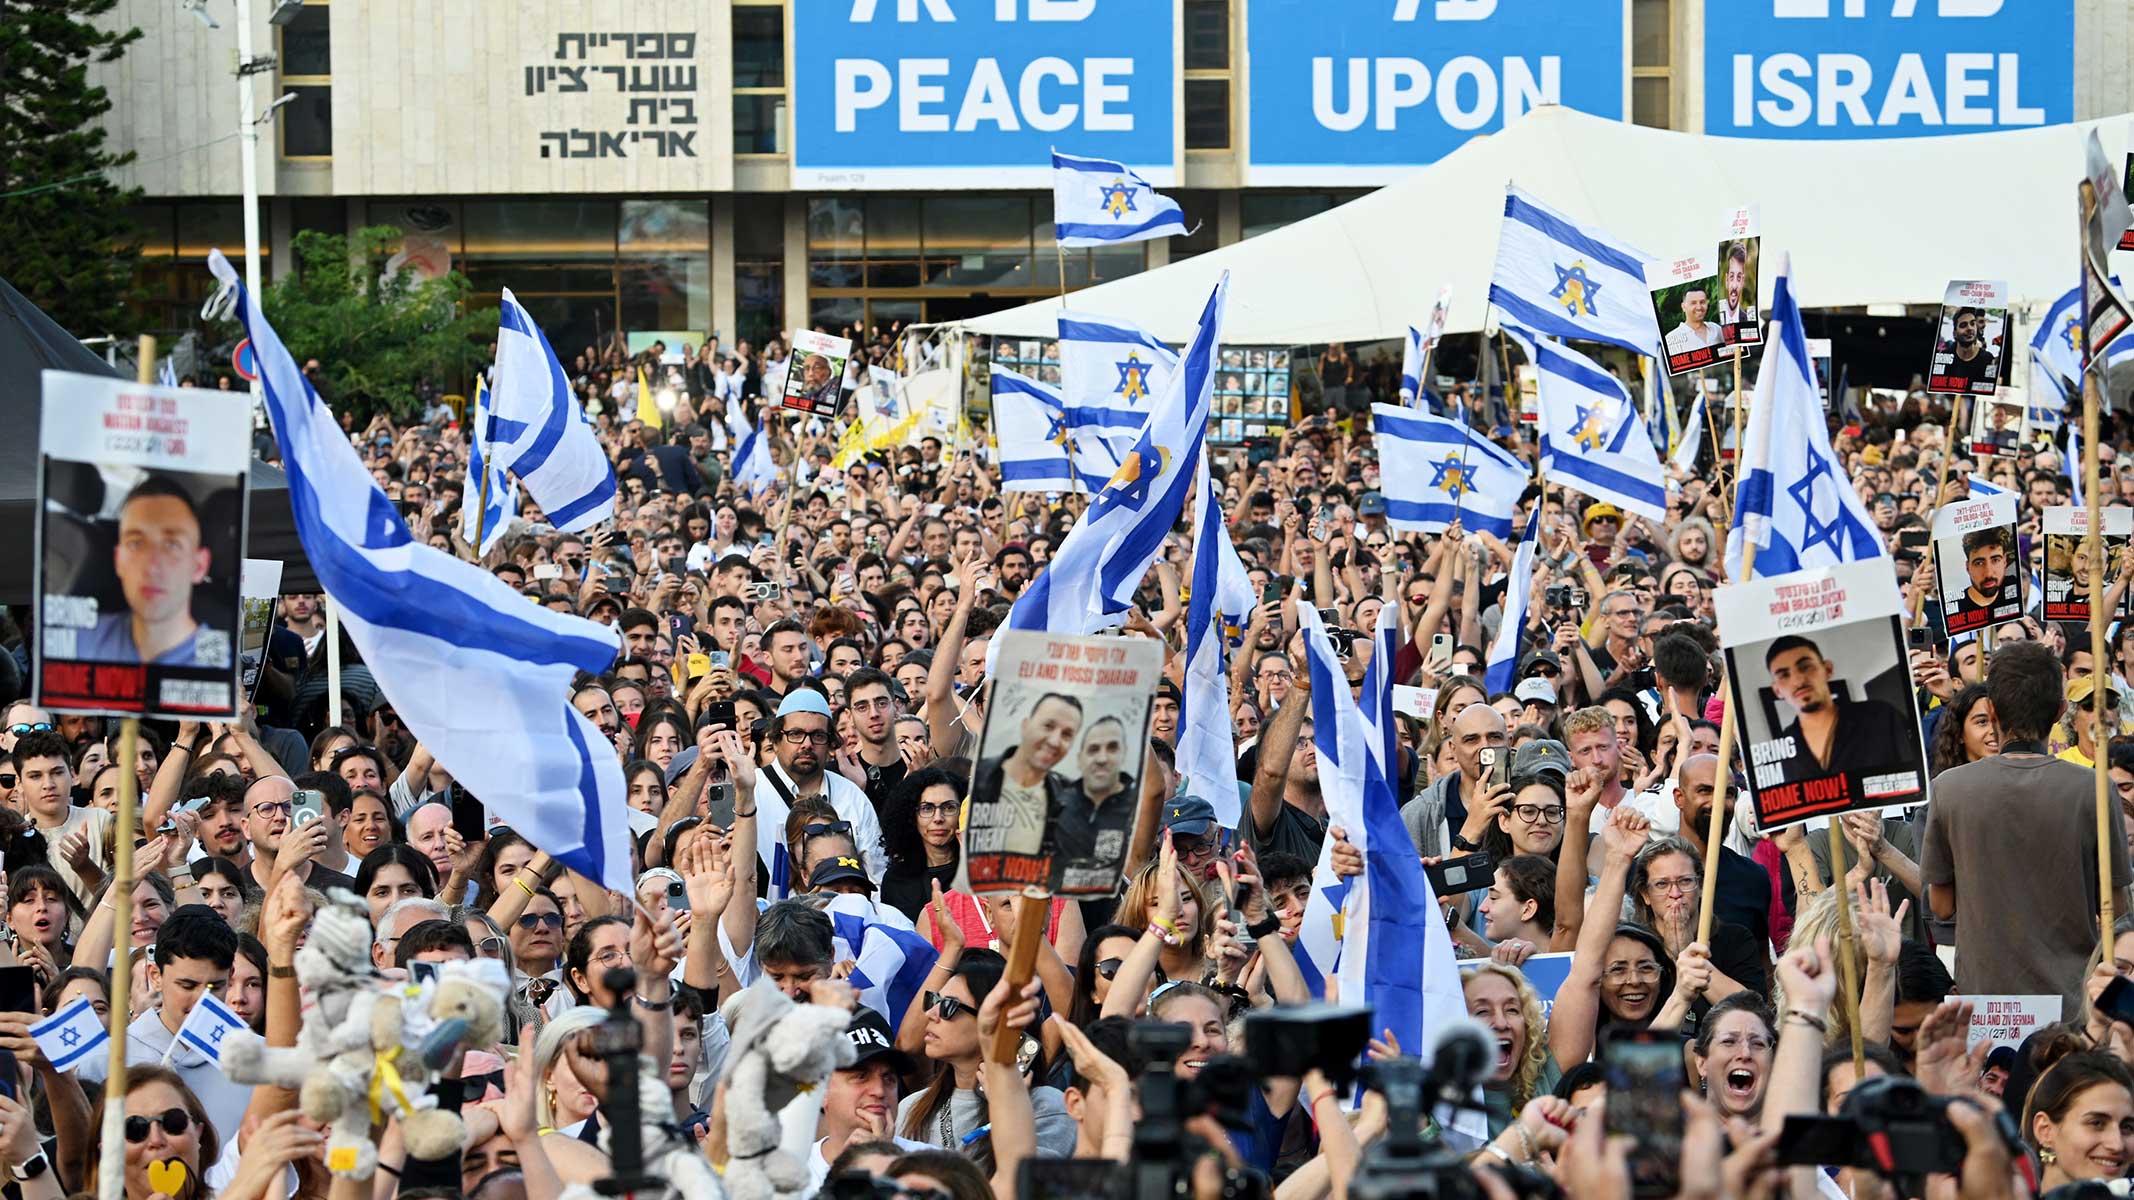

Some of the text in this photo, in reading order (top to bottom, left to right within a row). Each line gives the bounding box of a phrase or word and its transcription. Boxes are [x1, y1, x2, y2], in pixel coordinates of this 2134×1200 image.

[555, 33, 696, 59] ספריית
[835, 57, 1134, 132] PEACE
[1312, 56, 1560, 131] UPON
[1733, 53, 2045, 127] ISRAEL
[627, 98, 697, 124] בית
[540, 128, 697, 158] אריאלה
[1671, 352, 1691, 367] HOME
[1691, 346, 1712, 362] NOW!
[2047, 581, 2070, 591] BRING
[2047, 591, 2062, 602] HIM
[1769, 601, 1790, 615] ROM
[1947, 612, 1967, 627] HOME
[1967, 607, 1989, 623] NOW!
[2047, 603, 2068, 613] HOME
[1018, 660, 1035, 678] ELI
[1035, 663, 1058, 681] AND
[1061, 664, 1093, 684] YOSSI
[1751, 736, 1797, 766] BRING
[1754, 762, 1785, 789] HIM
[1759, 783, 1803, 814] HOME
[1803, 772, 1849, 805] NOW!
[970, 802, 1015, 827] BRING
[968, 827, 1007, 853] THEM
[838, 856, 860, 869] M
[1002, 856, 1051, 884] NOW!
[1972, 1014, 2035, 1025] GALI AND ZIV BERMAN
